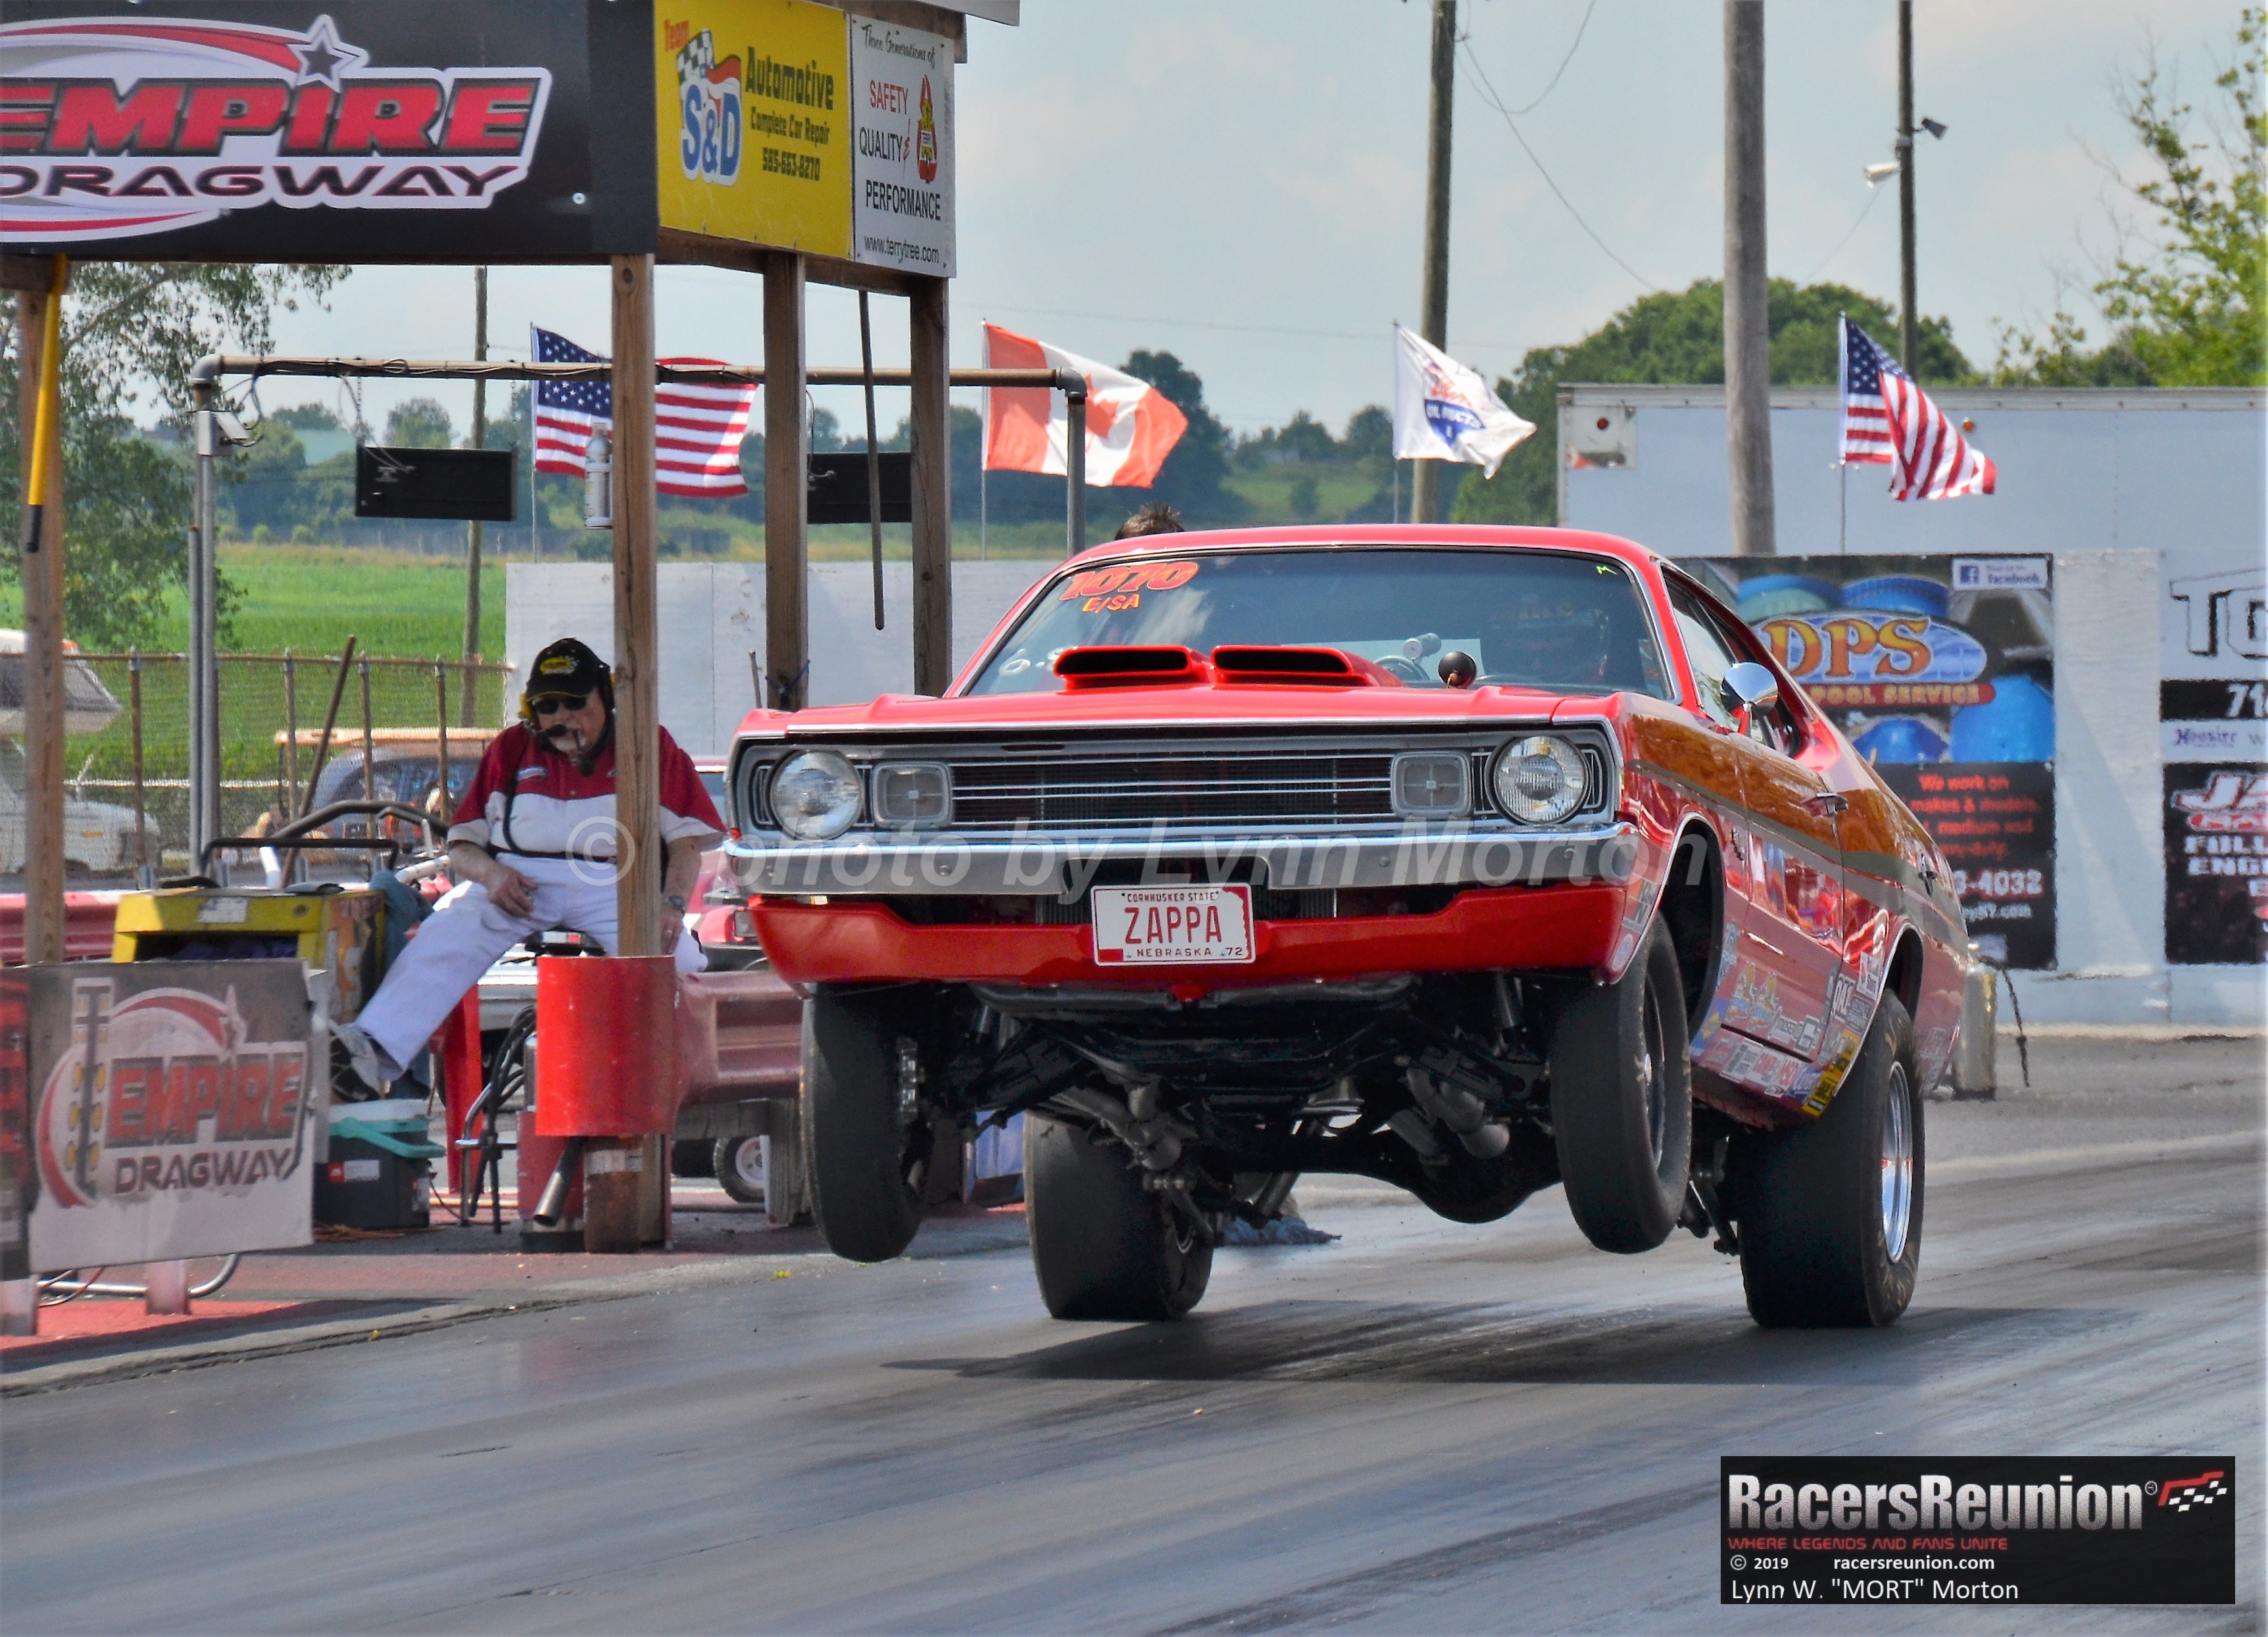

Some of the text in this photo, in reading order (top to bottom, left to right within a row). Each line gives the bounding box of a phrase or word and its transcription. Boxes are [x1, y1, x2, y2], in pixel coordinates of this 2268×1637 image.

[664, 19, 689, 51] Team
[746, 46, 834, 110] Automotive
[870, 80, 909, 114] SAFETY
[682, 84, 741, 176] S&D
[751, 107, 829, 147] Complete Car Repair
[859, 126, 902, 162] QUALITY
[866, 180, 941, 221] PERFORMANCE
[864, 235, 939, 264] www.terrytree.com
[1060, 562, 1199, 601] 1070
[1082, 594, 1141, 613] E/SA
[1762, 618, 1932, 677] DPS
[1810, 684, 1980, 704] POOL SERVICE
[2225, 682, 2268, 718] 71
[1127, 892, 1215, 902] CORNHUSKER STATE
[1124, 906, 1221, 944] ZAPPA
[1137, 947, 1243, 957] NEBRASKA 72
[105, 1053, 304, 1148] EMPIRE
[113, 1148, 291, 1195] DRAGWAY
